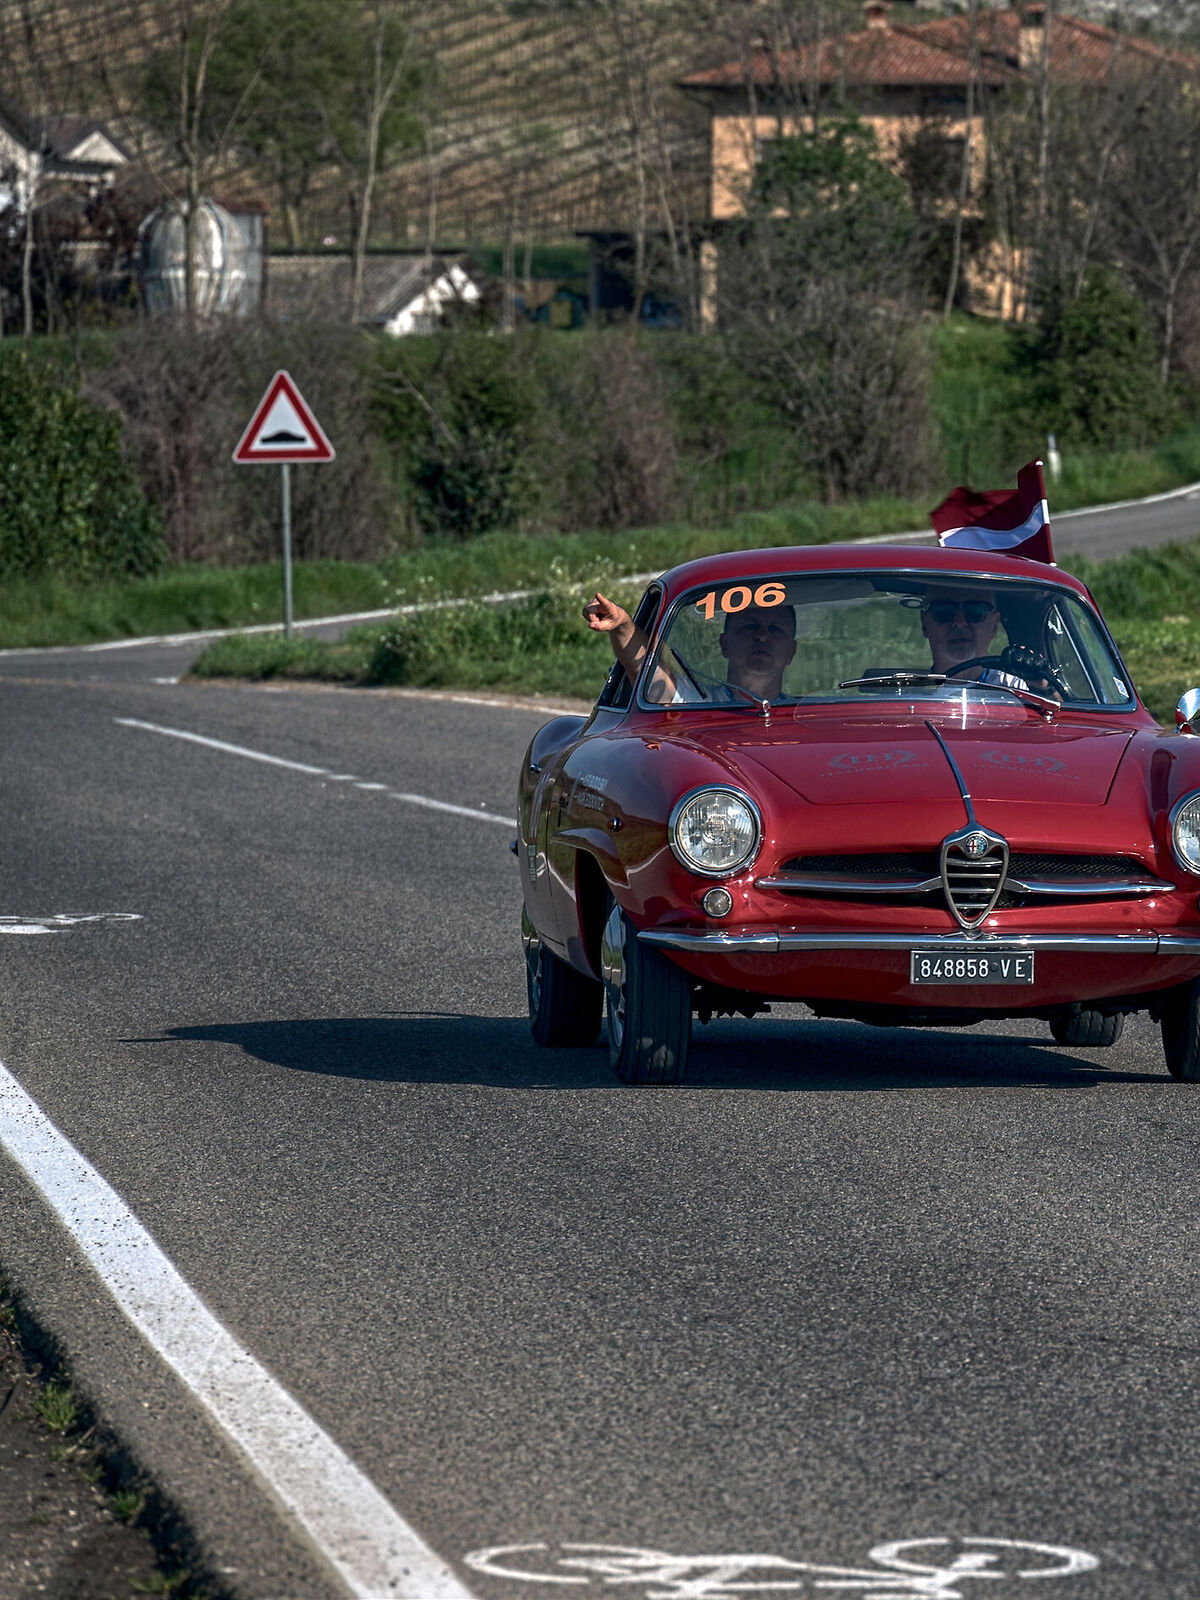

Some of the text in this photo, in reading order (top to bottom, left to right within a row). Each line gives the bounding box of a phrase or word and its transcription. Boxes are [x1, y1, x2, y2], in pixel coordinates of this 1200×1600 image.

[696, 582, 786, 620] 106
[920, 959, 1026, 978] 848858 VE
